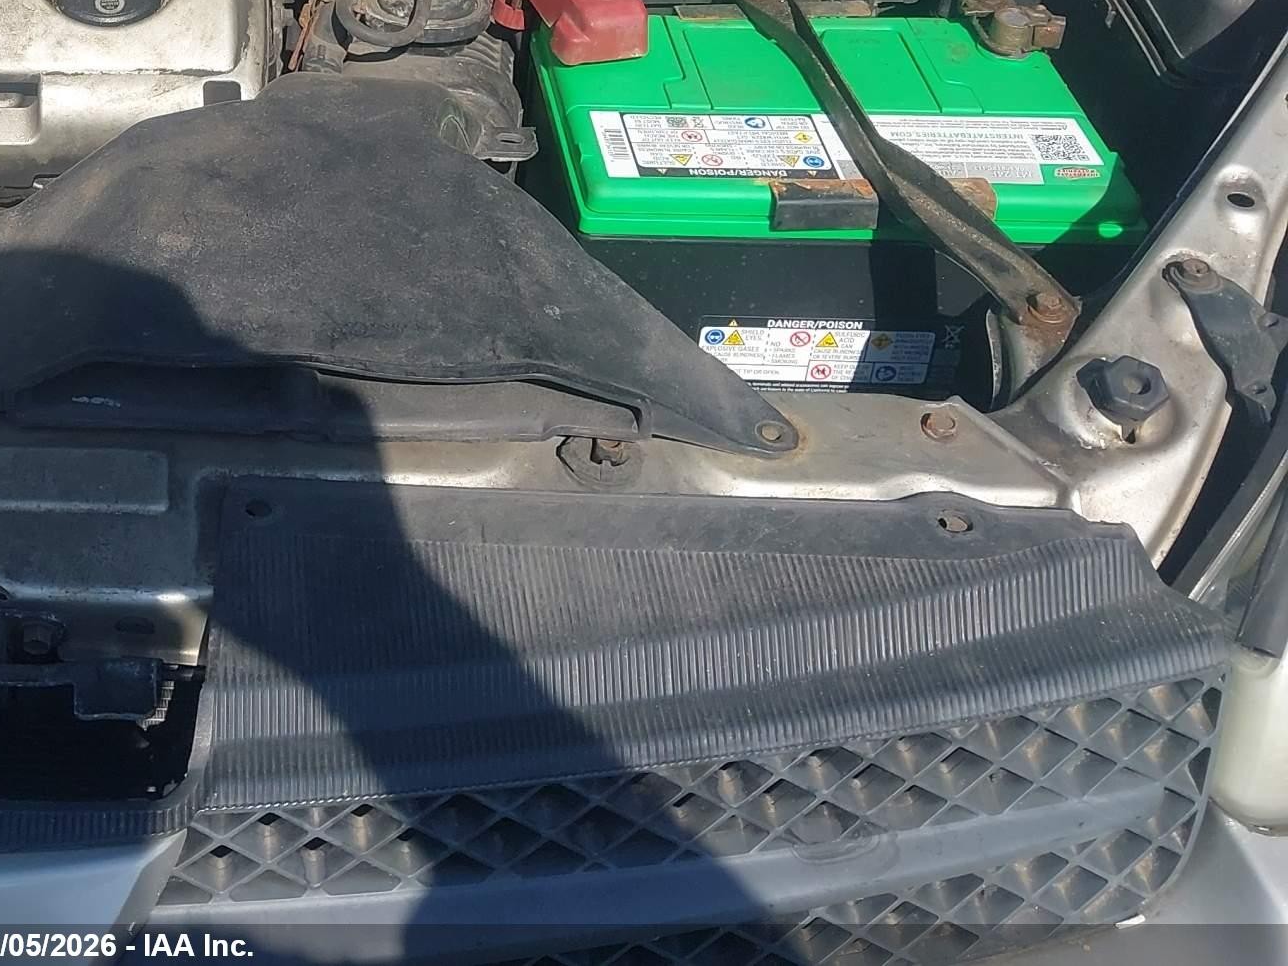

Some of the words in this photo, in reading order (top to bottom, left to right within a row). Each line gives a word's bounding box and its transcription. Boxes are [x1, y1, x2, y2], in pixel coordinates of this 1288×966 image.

[890, 131, 1023, 139] INTERSTATEBATTERIES.COM
[688, 167, 787, 177] DANGER/POISON
[767, 319, 863, 330] DANGER/POISON
